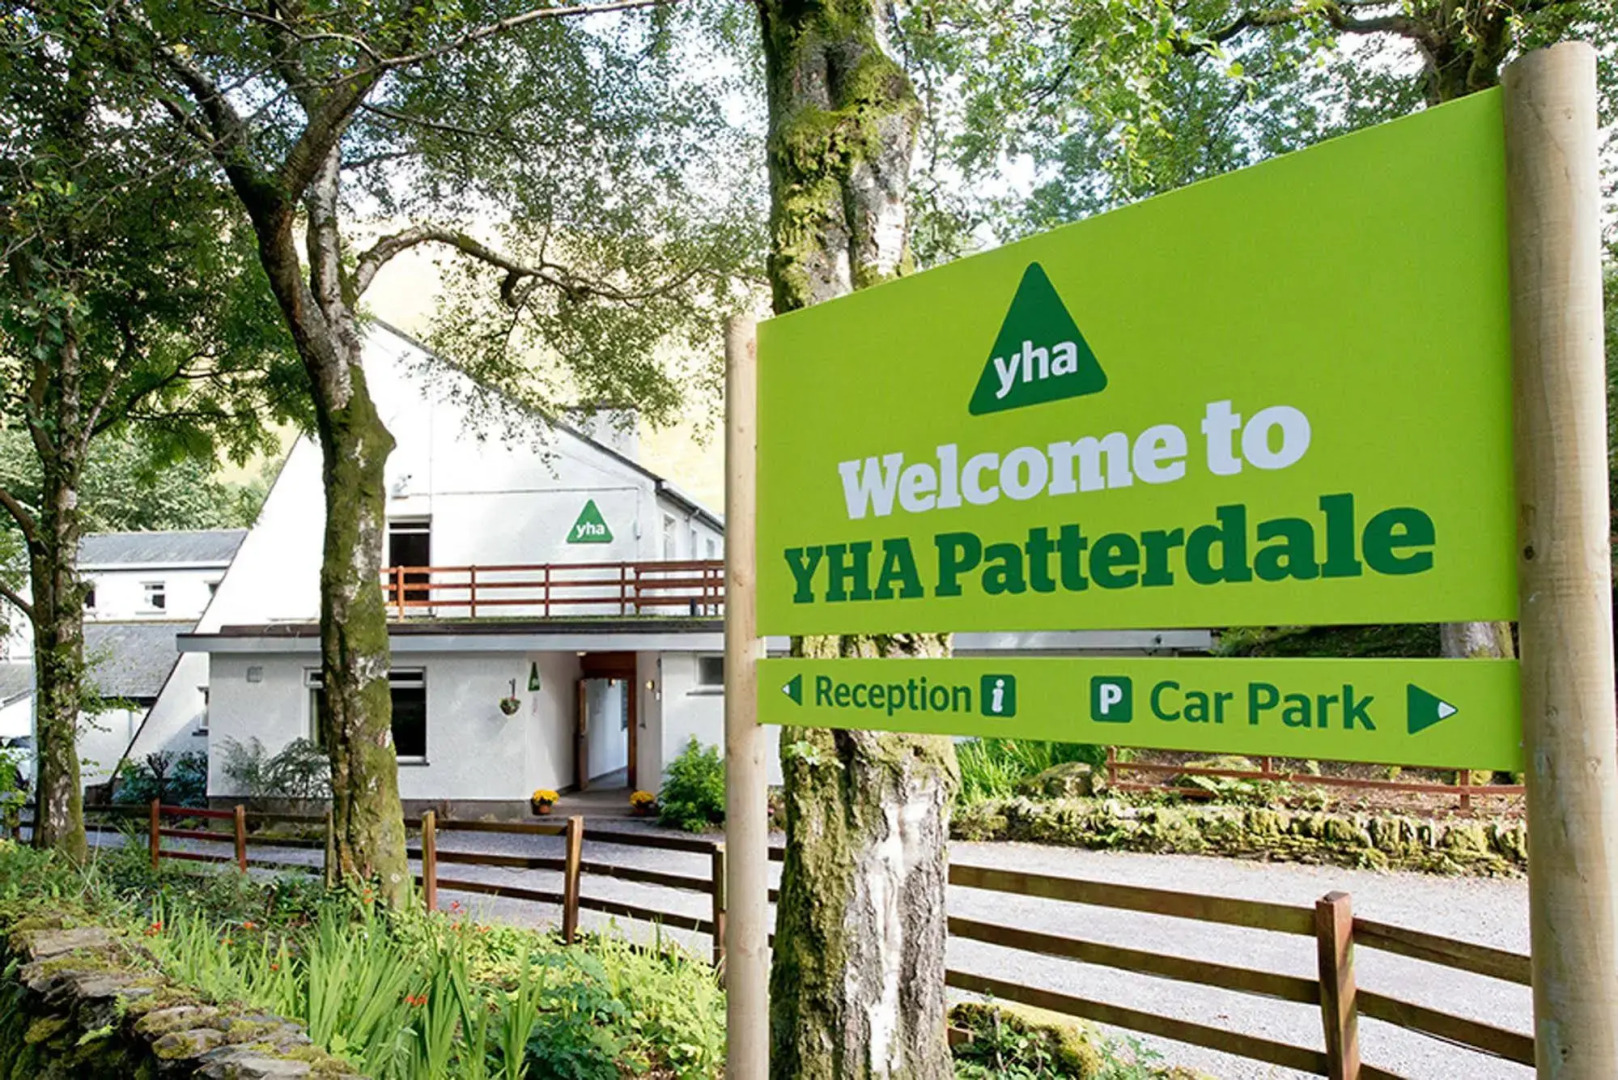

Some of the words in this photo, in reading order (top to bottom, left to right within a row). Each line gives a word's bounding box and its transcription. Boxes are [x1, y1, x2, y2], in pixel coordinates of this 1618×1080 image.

[993, 340, 1078, 399] yha
[838, 424, 1188, 520] Welcome
[1201, 399, 1312, 476] to
[576, 521, 605, 539] yha
[784, 537, 925, 604] YHA
[934, 492, 1437, 598] Patterdale
[814, 675, 973, 715] Reception
[1099, 683, 1123, 715] P
[1149, 680, 1234, 725] Car
[1247, 682, 1378, 732] Park
